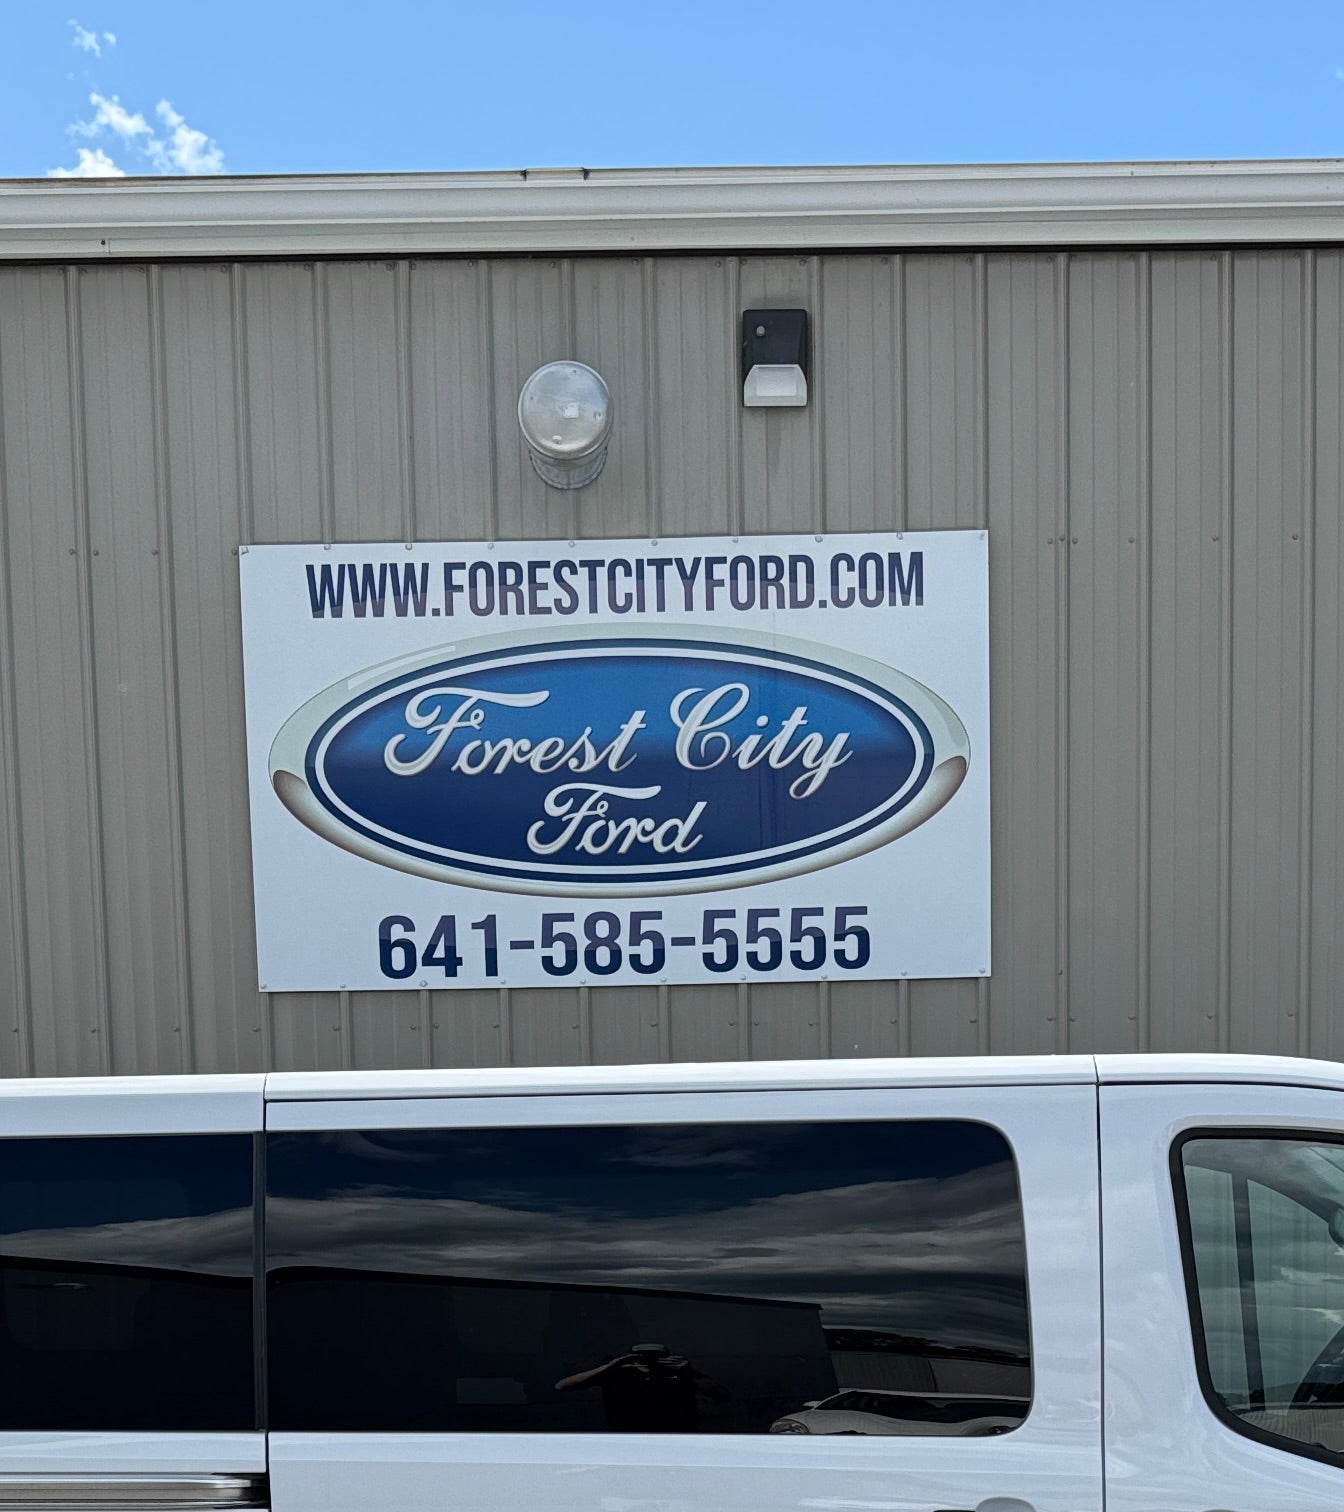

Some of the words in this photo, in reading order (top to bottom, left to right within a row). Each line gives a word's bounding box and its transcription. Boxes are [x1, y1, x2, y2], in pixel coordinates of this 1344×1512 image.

[306, 551, 925, 619] WWW.FORESTCITYFORD.COM
[384, 687, 647, 776] Forest
[669, 682, 854, 799] City
[526, 783, 707, 855] Ford
[378, 905, 871, 980] 641-585-5555
